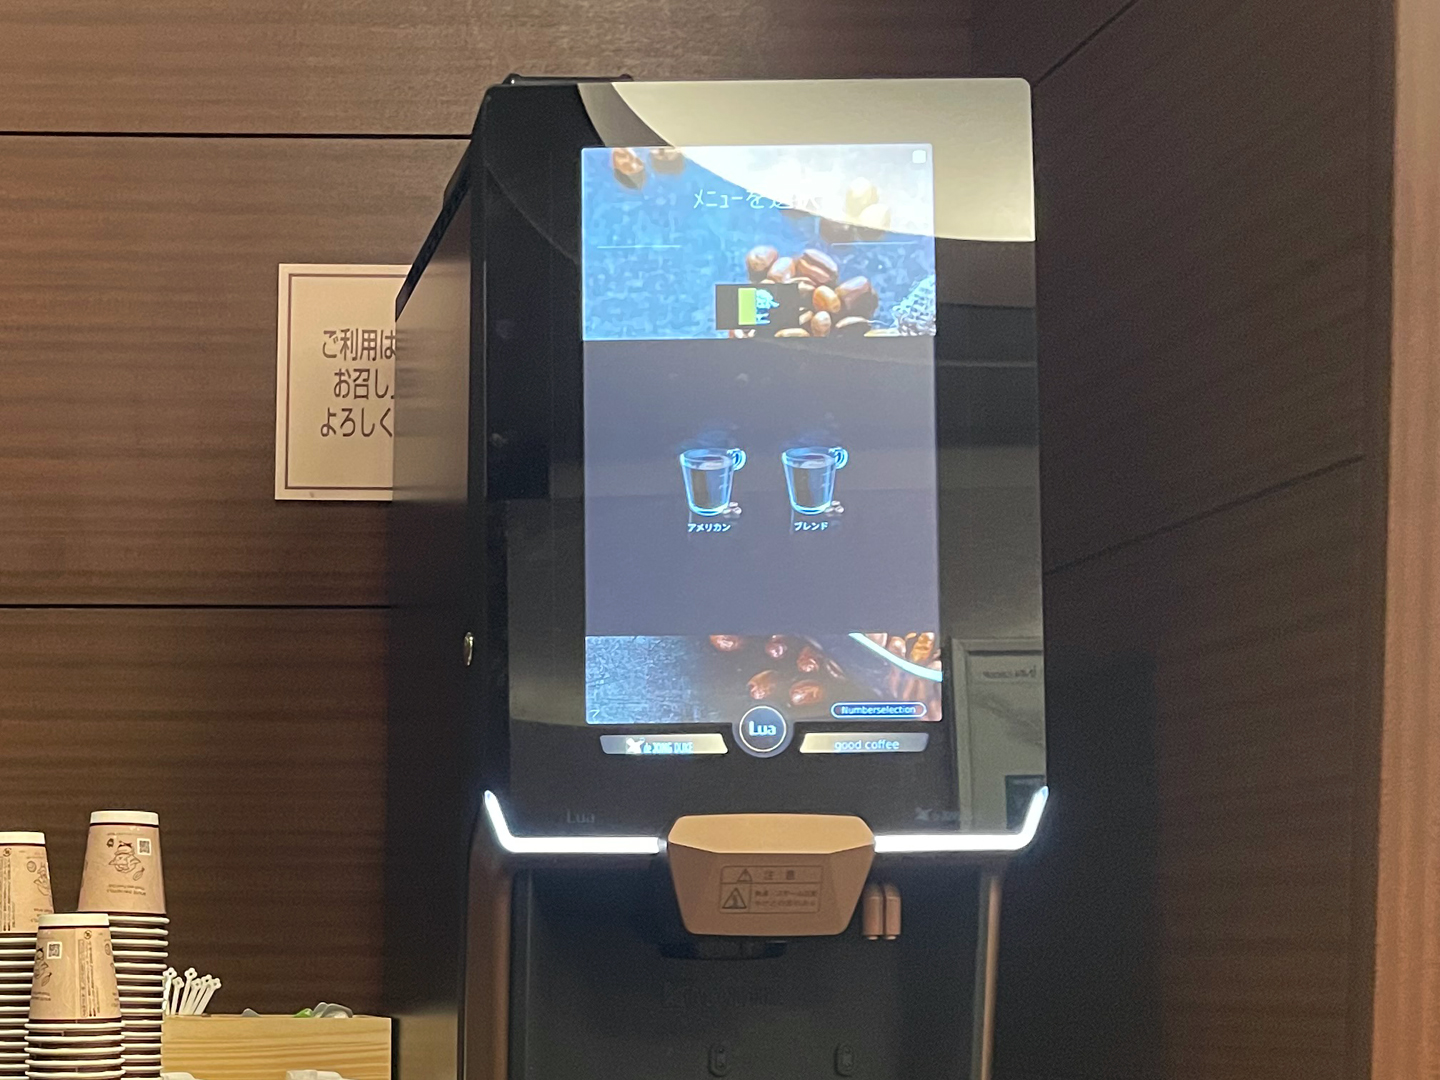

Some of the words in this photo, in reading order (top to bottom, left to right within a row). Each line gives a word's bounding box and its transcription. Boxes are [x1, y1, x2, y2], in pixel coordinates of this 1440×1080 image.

[693, 189, 822, 210] メニューを
[322, 328, 396, 361] ご利用は
[333, 368, 394, 400] お召し
[320, 407, 393, 438] よろしく
[687, 523, 731, 532] アメリカン
[794, 521, 828, 531] ブレンド
[841, 705, 916, 715] Numberselection
[748, 720, 777, 736] Lua
[834, 740, 862, 751] good
[864, 739, 900, 750] coffee
